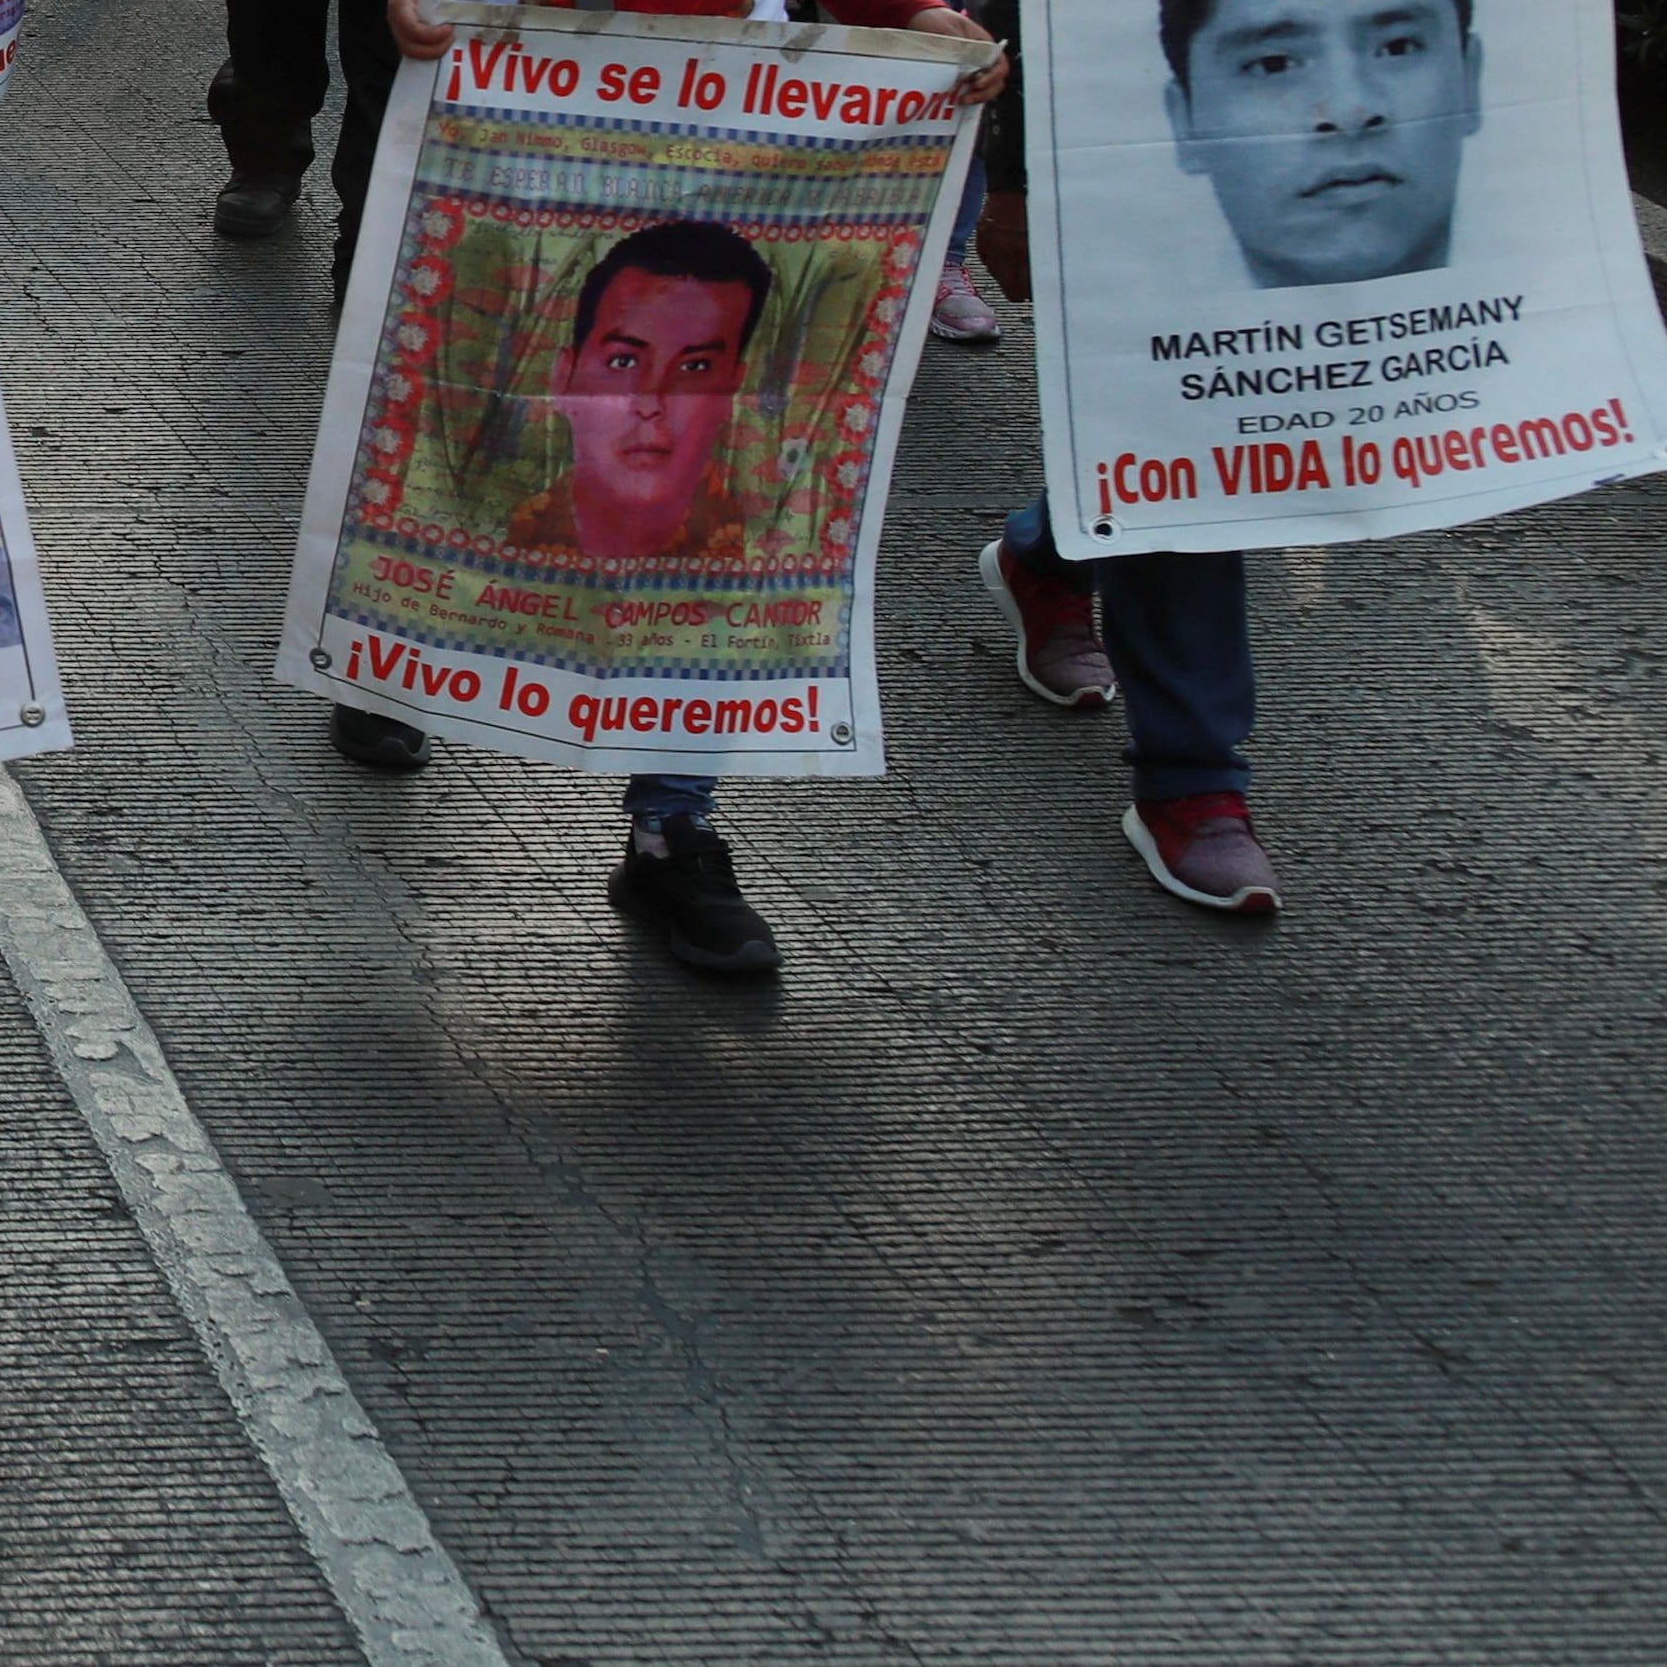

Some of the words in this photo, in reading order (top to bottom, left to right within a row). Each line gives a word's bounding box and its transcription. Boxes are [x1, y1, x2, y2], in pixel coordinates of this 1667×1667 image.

[444, 36, 581, 103] ¡Vivo
[595, 58, 661, 106] se
[677, 56, 728, 111] lo
[742, 62, 959, 128] llevaron!
[1150, 320, 1303, 362] MARTÍN
[1314, 294, 1525, 350] GETSEMANY
[1179, 359, 1372, 401] SÁNCHEZ
[1379, 340, 1510, 382] GARCÍA
[1236, 409, 1335, 436] EDAD
[1348, 403, 1386, 428] 20
[1394, 389, 1482, 418] AÑOS
[1096, 448, 1198, 516] ¡Con
[1221, 438, 1331, 496] VIDA
[1342, 433, 1382, 487] lo
[1391, 395, 1637, 491] queremos!
[371, 555, 456, 602] JOSÉ
[475, 581, 580, 622] ÁNGEL
[345, 634, 482, 704] ¡Vivo
[498, 665, 551, 719] lo
[567, 684, 821, 744] queremos!
